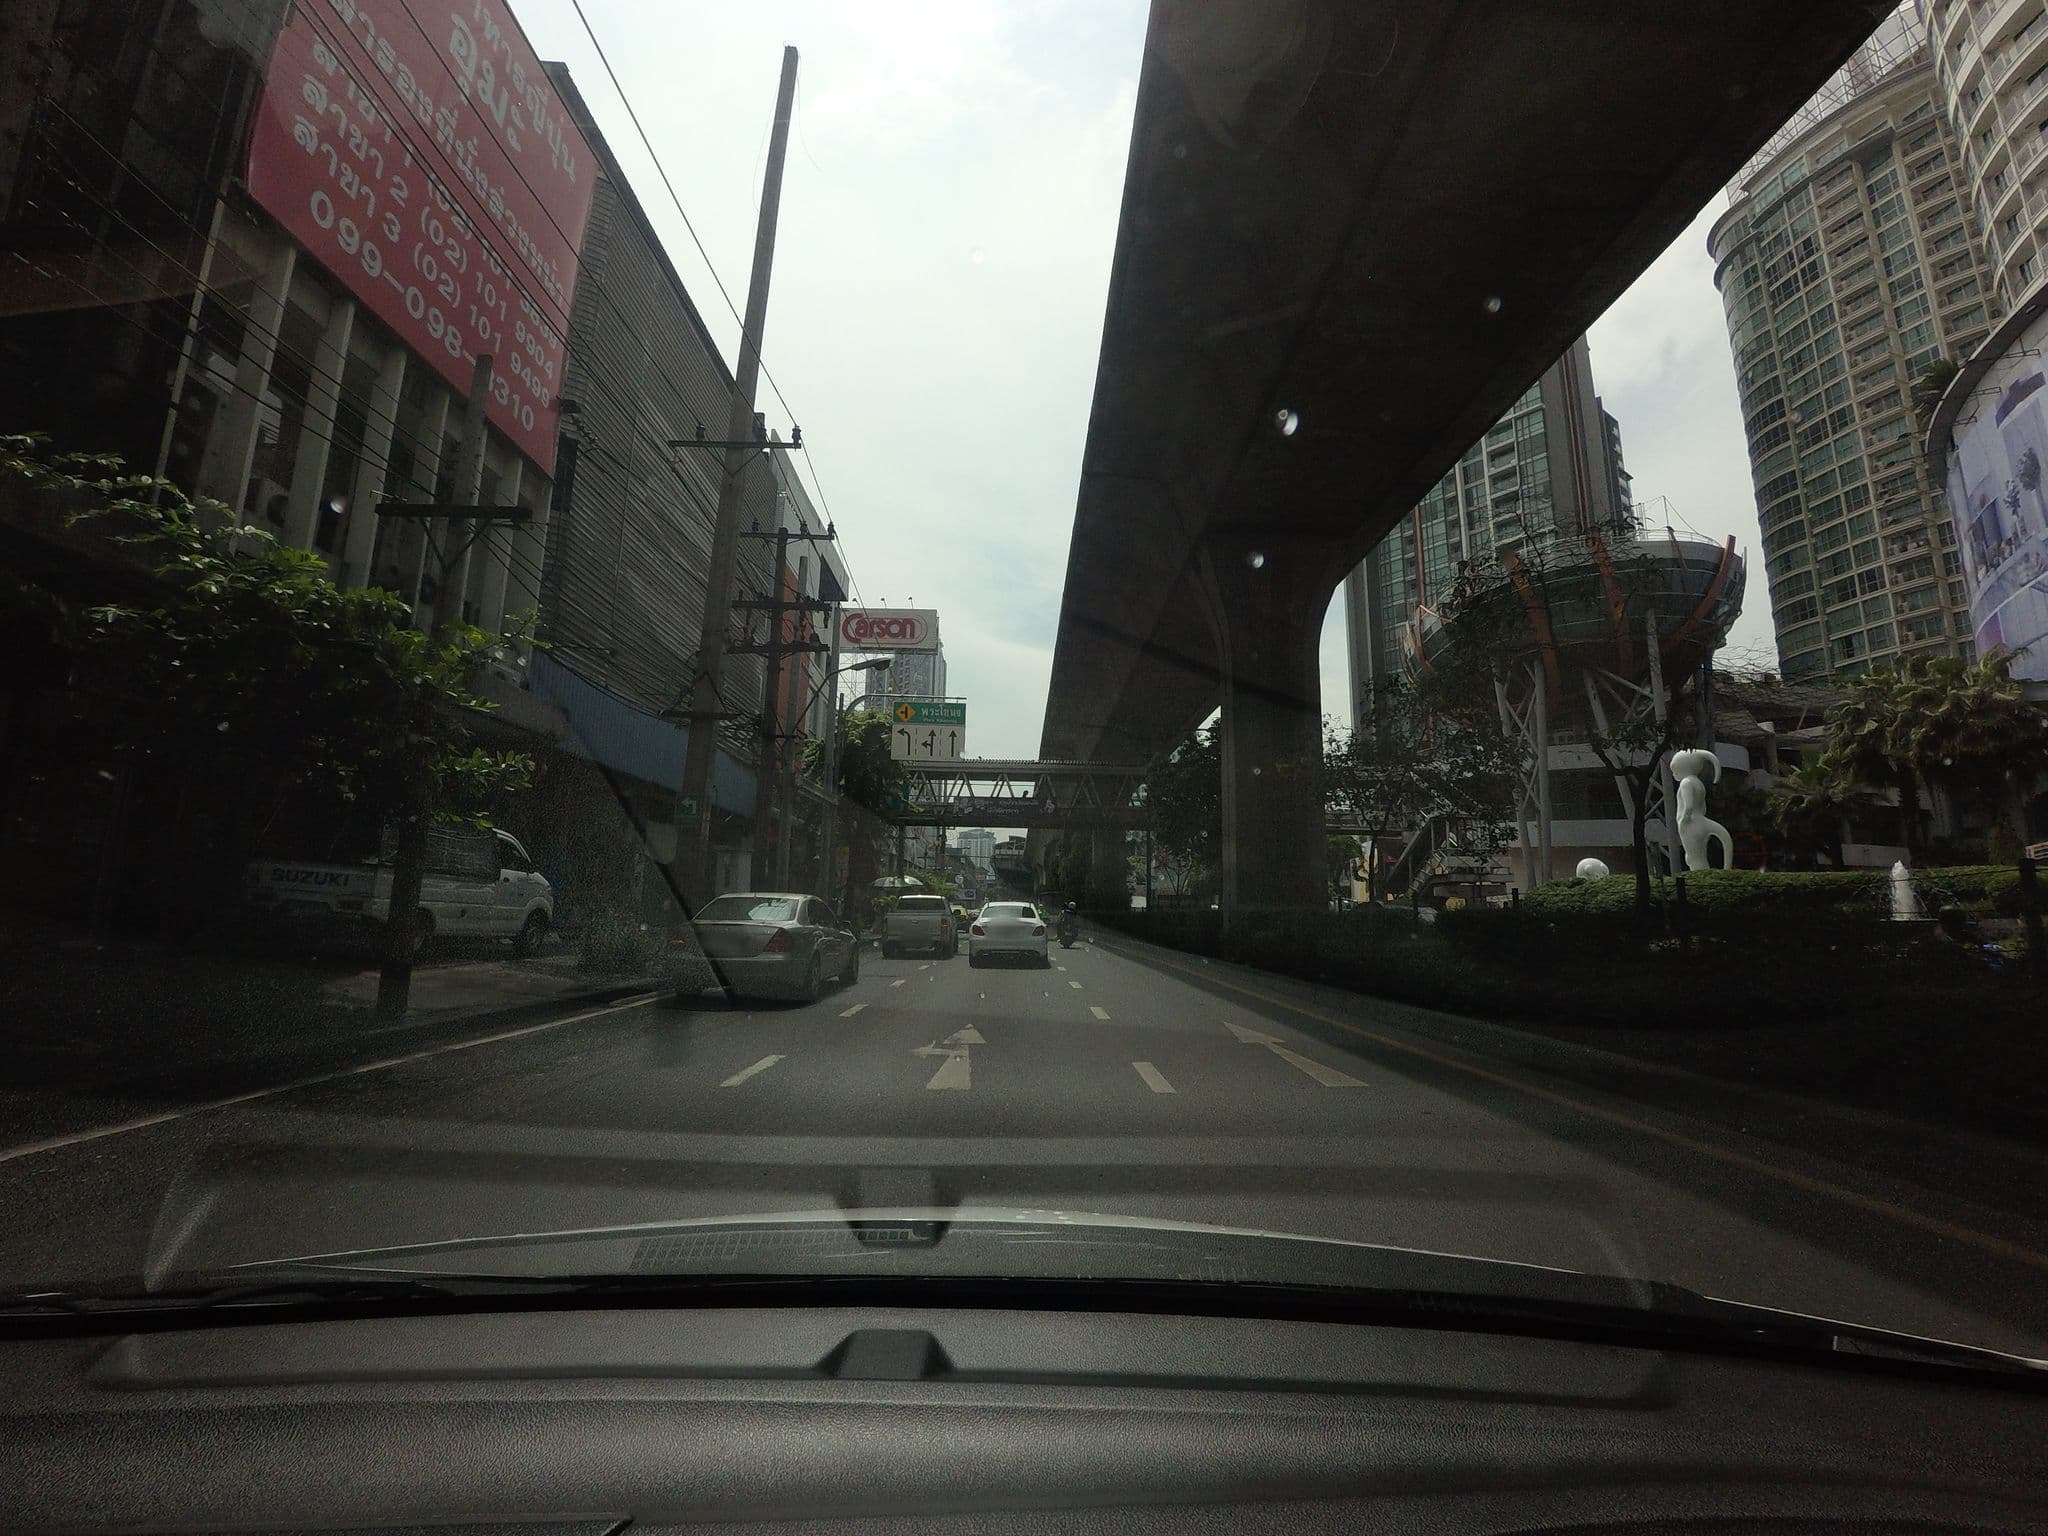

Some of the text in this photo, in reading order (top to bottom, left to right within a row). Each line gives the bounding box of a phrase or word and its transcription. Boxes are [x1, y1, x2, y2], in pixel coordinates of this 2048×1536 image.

[293, 114, 550, 409] สาขา 3 (02) 101 9499
[302, 73, 554, 380] สาขา 2 (02) 101 9904
[842, 613, 916, 644] Carson
[271, 867, 350, 887] SUZUKI
